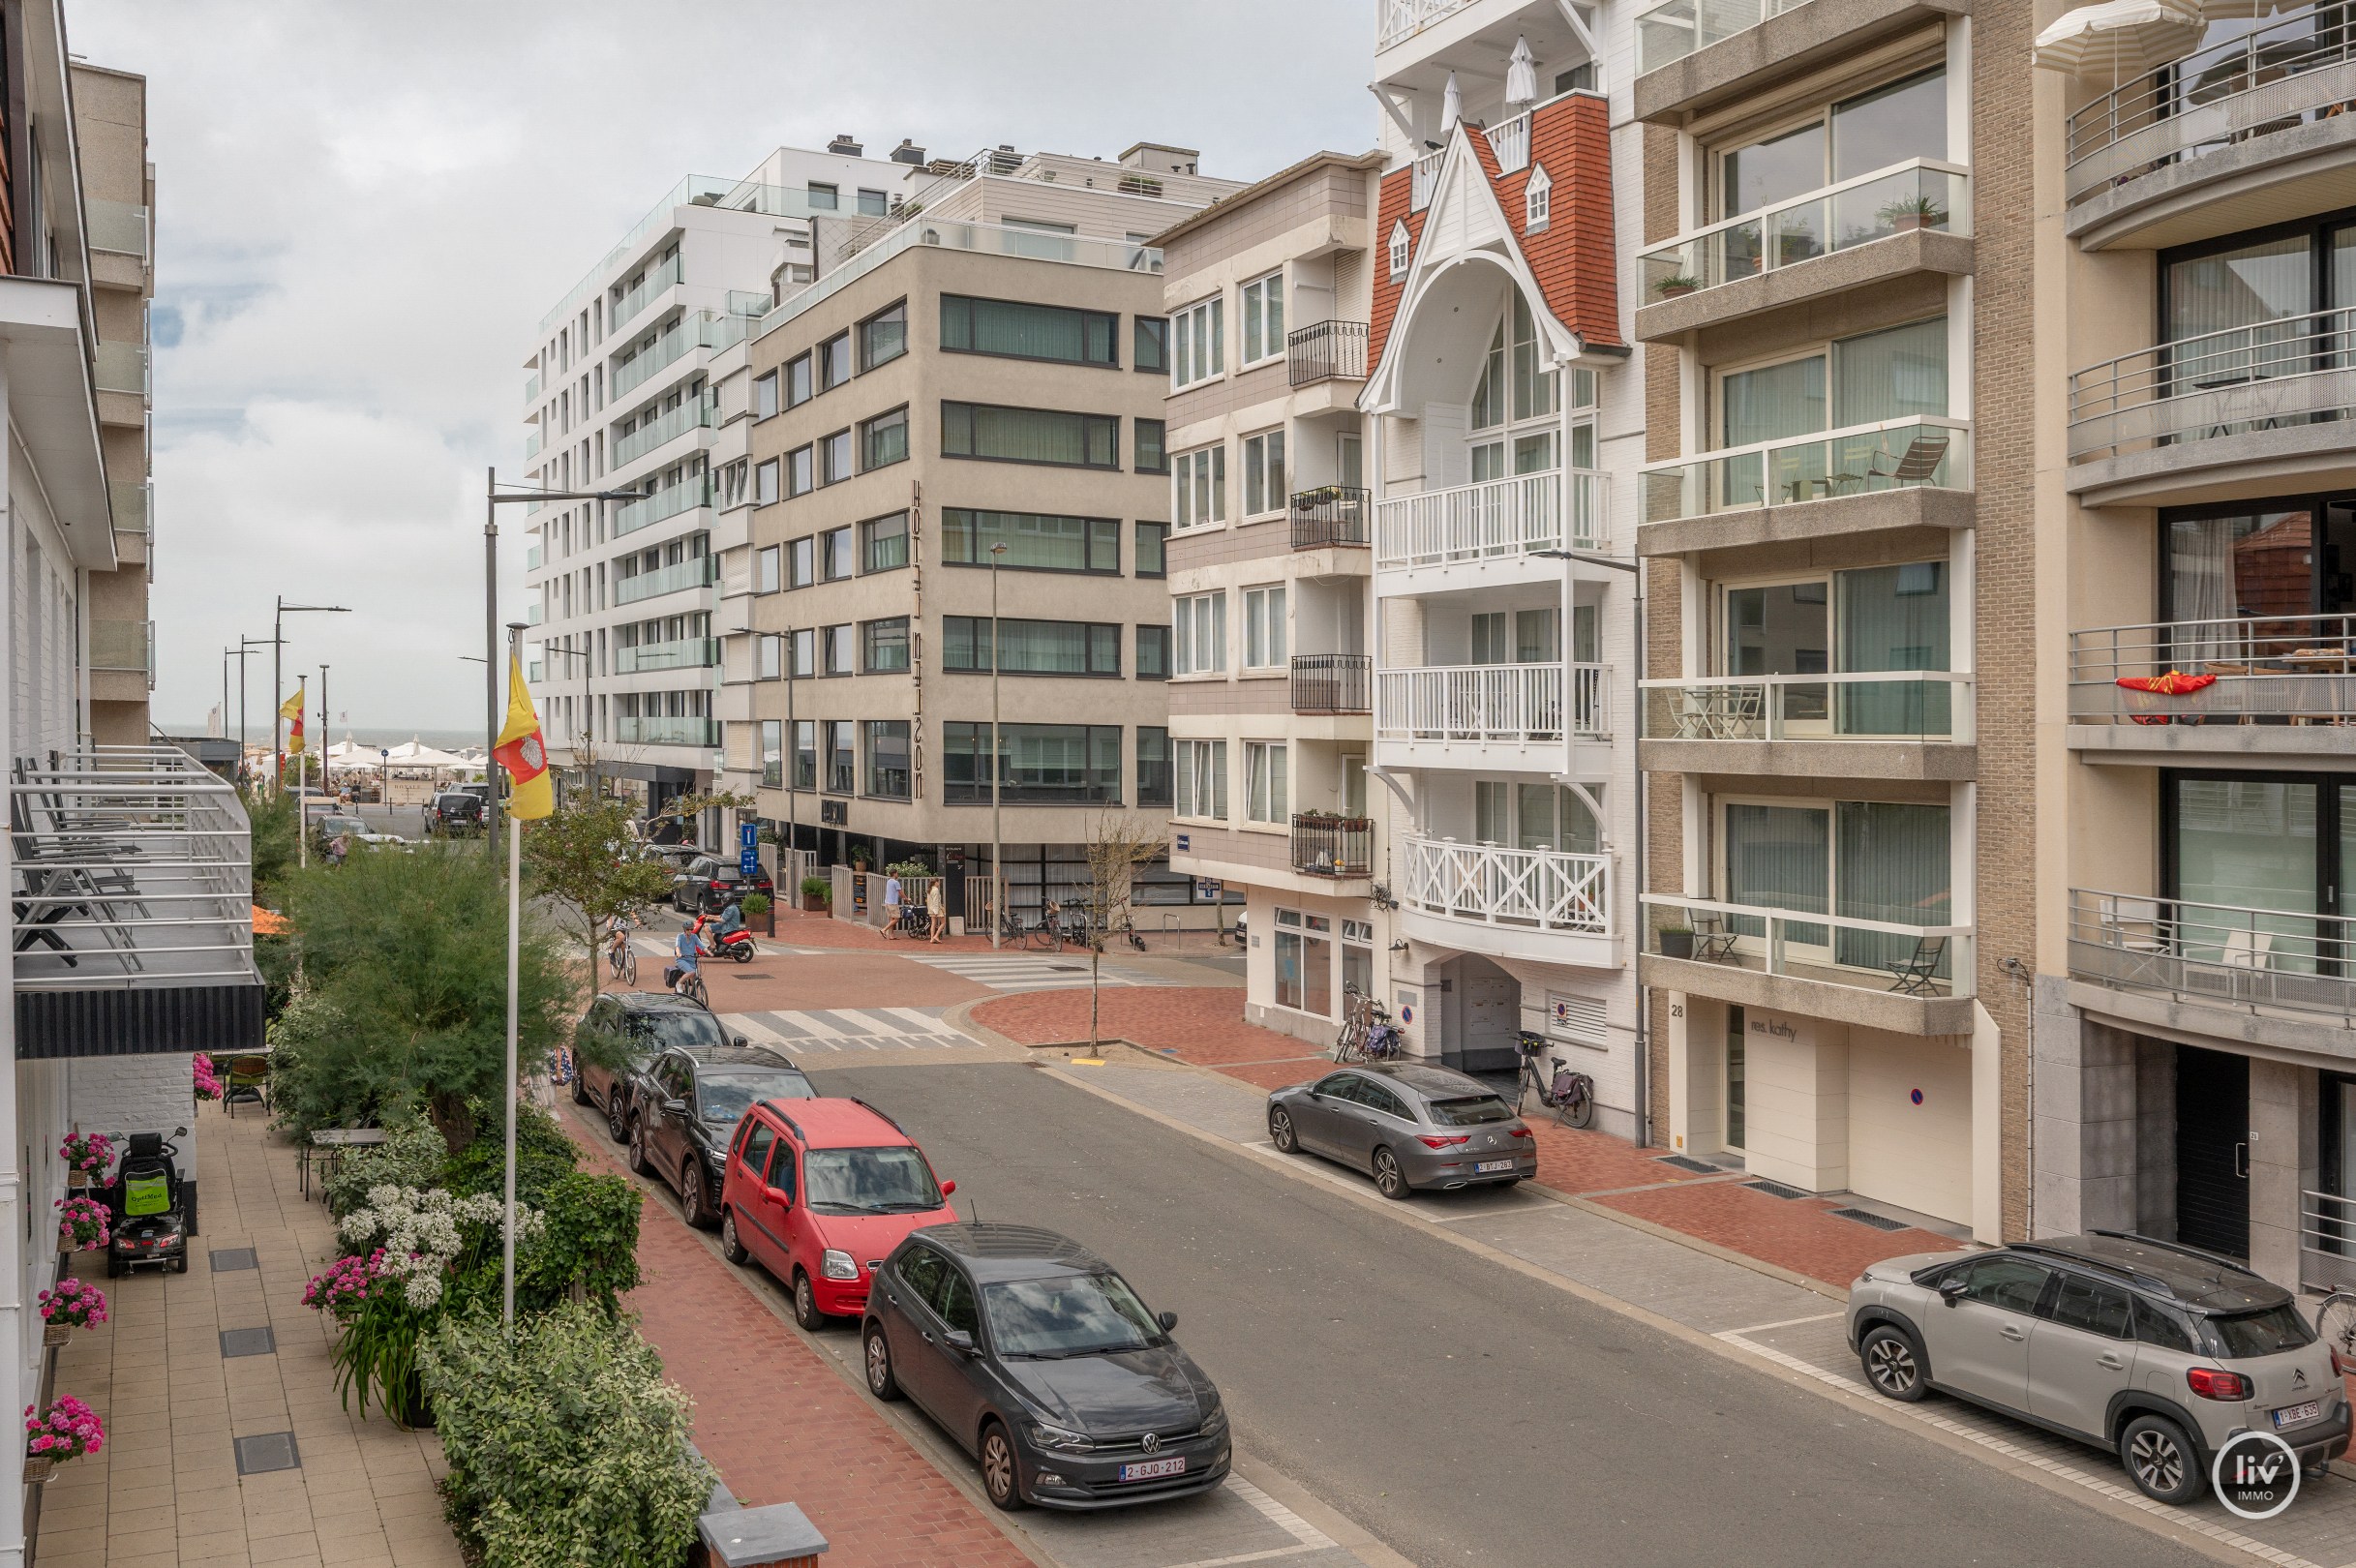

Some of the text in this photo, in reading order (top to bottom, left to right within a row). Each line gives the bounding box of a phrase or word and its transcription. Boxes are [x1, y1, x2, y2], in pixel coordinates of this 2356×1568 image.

[1671, 1004, 1683, 1018] 28
[1751, 1019, 1797, 1042] res. kathy
[2280, 1403, 2318, 1423] 1-XBE-635
[1127, 1460, 1184, 1478] 2-GJQ-212
